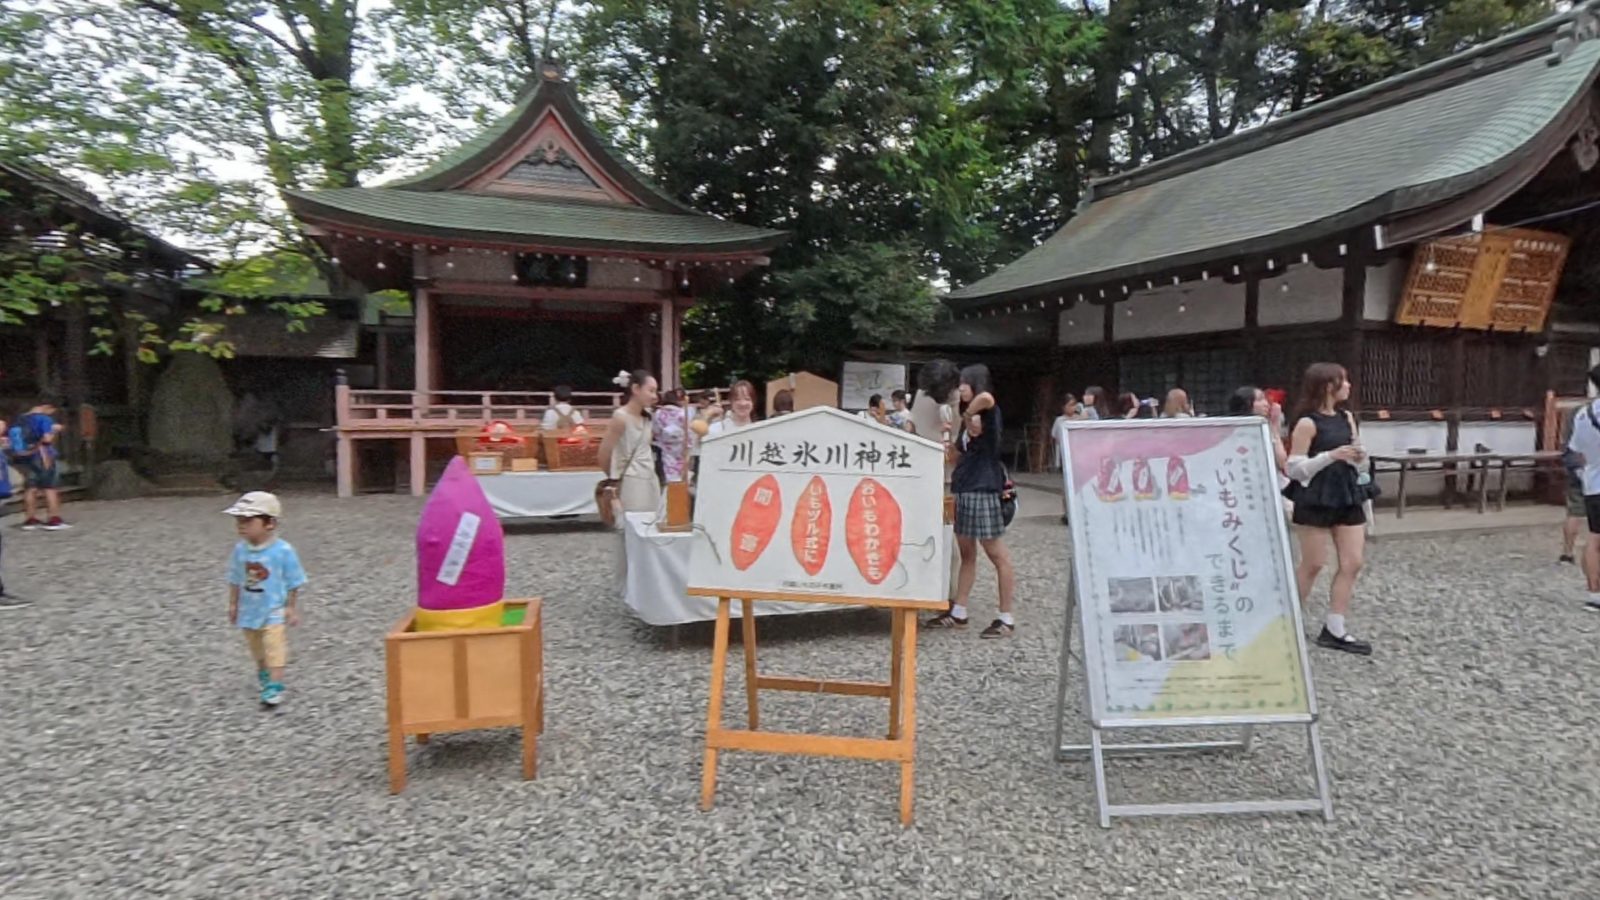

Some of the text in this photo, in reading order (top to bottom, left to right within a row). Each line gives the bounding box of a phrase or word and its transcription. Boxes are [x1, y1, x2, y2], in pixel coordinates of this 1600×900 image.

[728, 440, 912, 472] 川越氷川神社
[1206, 553, 1237, 662] できるまで
